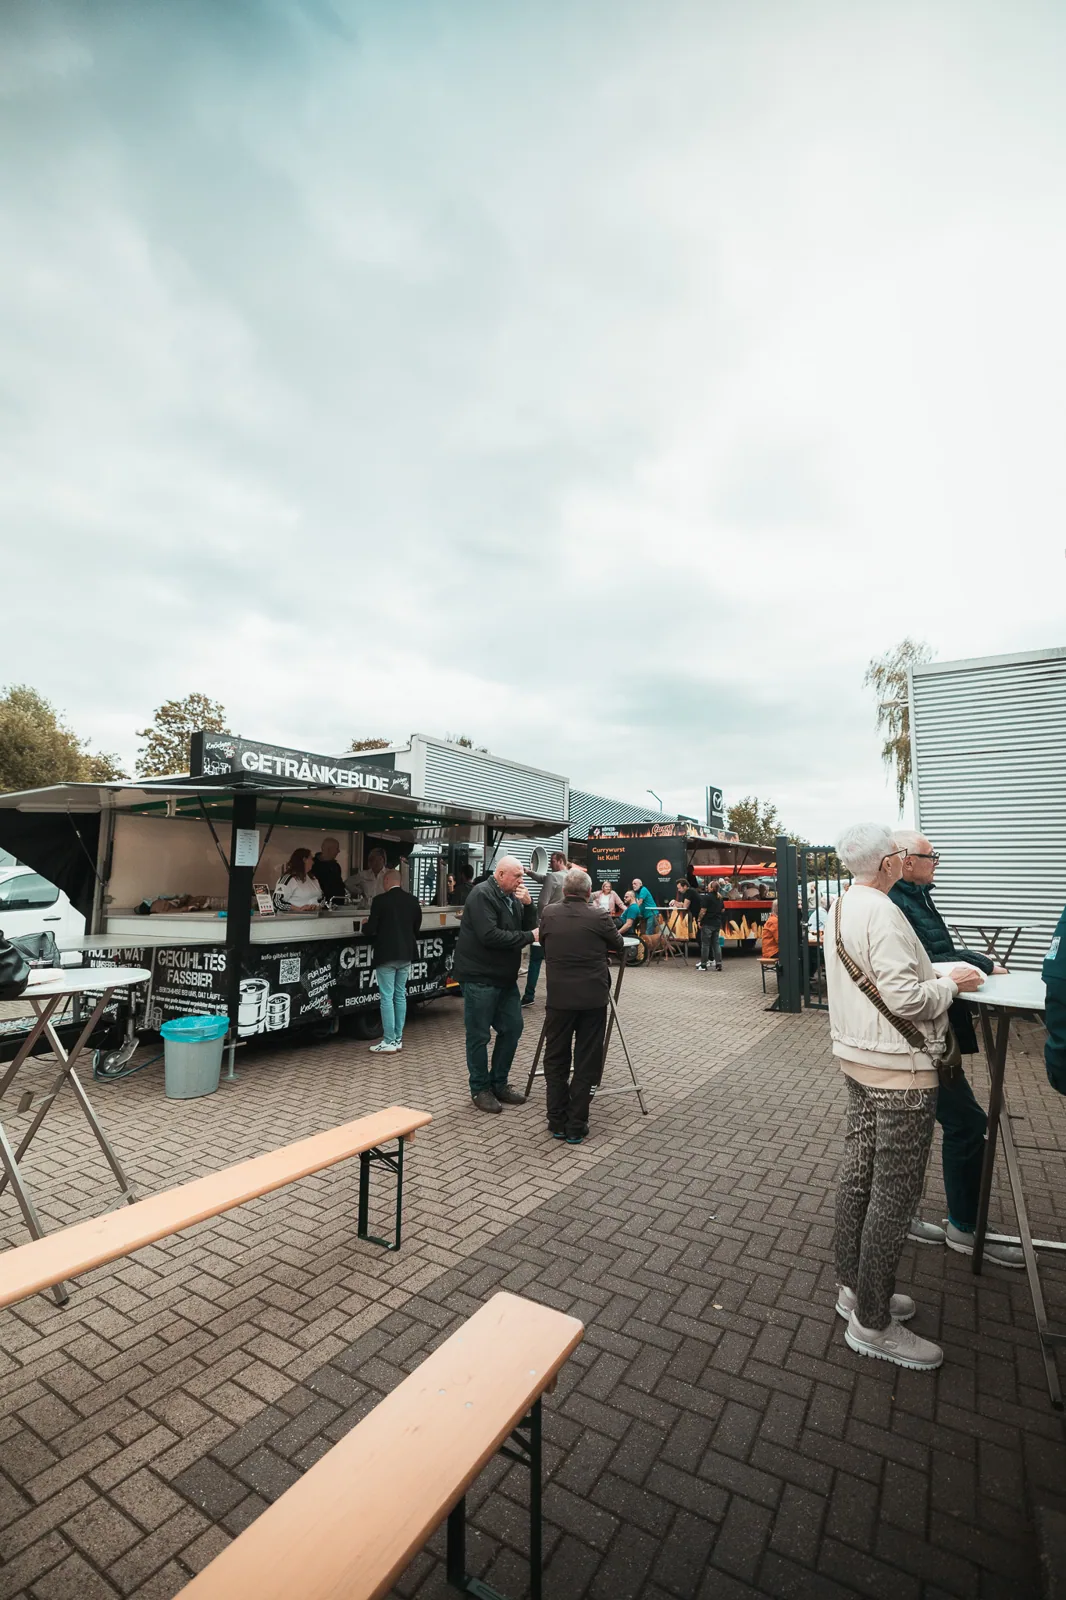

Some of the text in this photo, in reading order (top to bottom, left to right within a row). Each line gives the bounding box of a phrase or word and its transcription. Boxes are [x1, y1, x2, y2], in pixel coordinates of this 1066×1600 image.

[241, 751, 390, 792] GETRÄNKEBUDE
[124, 947, 146, 962] WAT
[157, 947, 227, 972] GEKÜHLTES
[167, 969, 213, 988] FASSBIER
[307, 963, 332, 980] FÜR DAS
[310, 972, 332, 988] FRISCH
[198, 991, 207, 1000] DAT
[207, 991, 221, 1001] LÄUFT
[307, 978, 337, 998] GEZAPFTE
[345, 992, 381, 1007] BEKOMMS
[408, 984, 420, 994] DAT
[421, 981, 439, 992] LÄUFT
